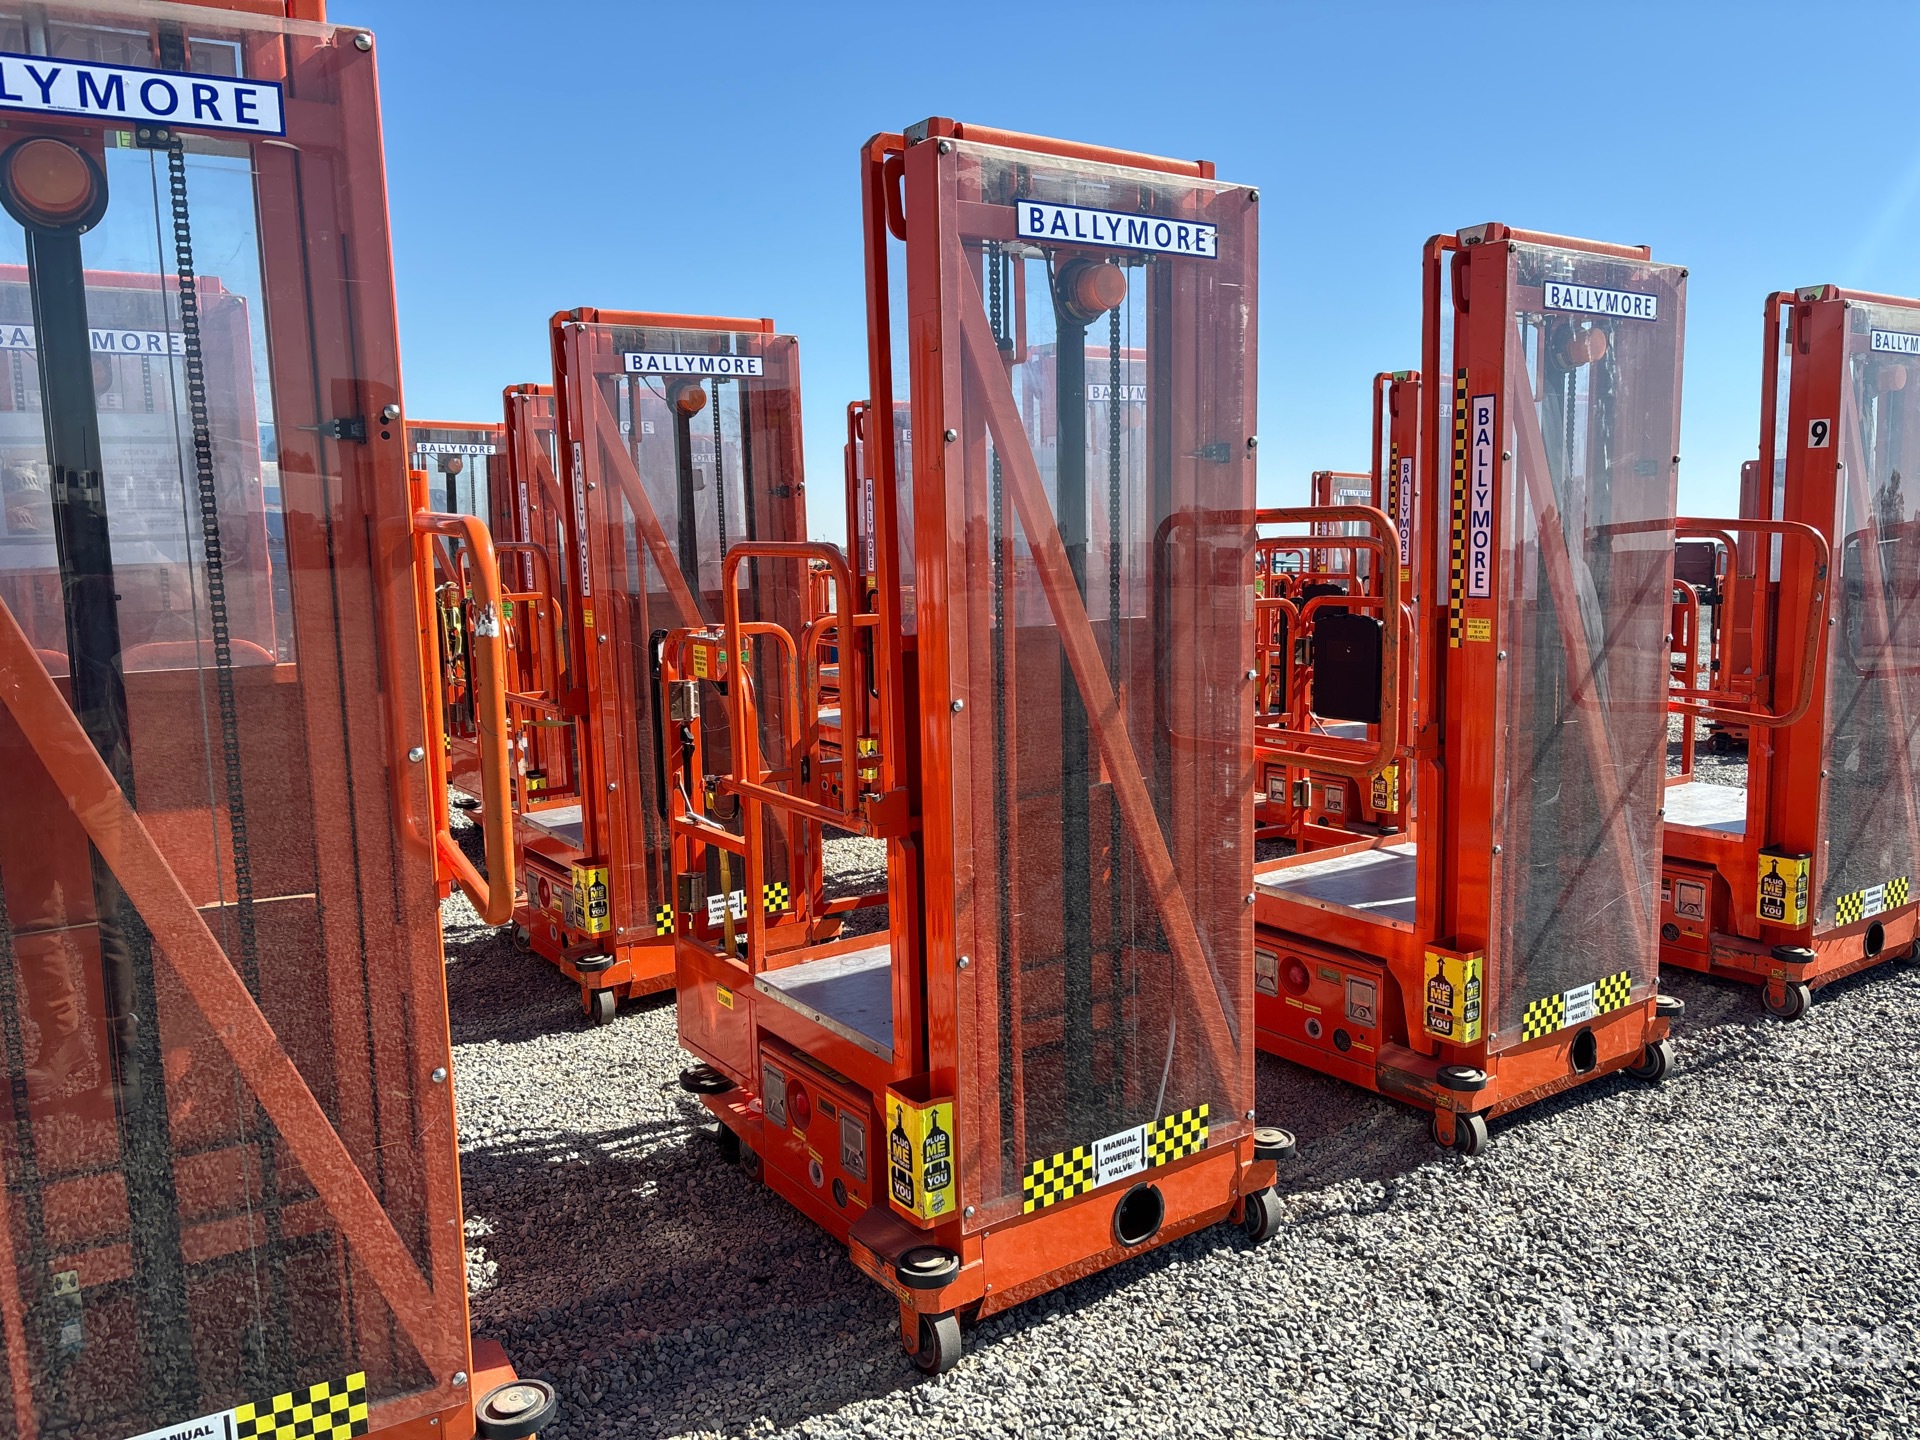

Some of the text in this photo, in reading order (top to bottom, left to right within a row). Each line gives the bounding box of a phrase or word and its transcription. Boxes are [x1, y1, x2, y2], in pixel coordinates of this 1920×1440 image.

[1029, 207, 1207, 252] BALLYMORE
[1551, 286, 1652, 317] BALLYMORE
[1875, 333, 1919, 352] BALLYM
[632, 355, 757, 374] BALLYMORE
[1810, 420, 1828, 447] 9
[421, 443, 492, 454] BALLYMORE
[1471, 406, 1490, 590] BALLYMORE
[574, 448, 589, 591] BALLYMORE
[1400, 463, 1411, 561] BALLYMORE
[866, 483, 875, 569] BALLYMORE
[521, 487, 533, 586] BALLYORE
[1374, 783, 1386, 791] ME
[1764, 877, 1783, 886] PLUG
[1764, 883, 1783, 894] ME
[590, 889, 604, 898] ME
[711, 895, 737, 905] MANAL
[591, 908, 606, 916] YOU
[1763, 906, 1782, 915] YOU
[1430, 980, 1451, 992] PLUG
[1466, 986, 1479, 997] ME
[1430, 987, 1450, 1003] ME
[1430, 1017, 1450, 1030] YOU
[892, 1132, 910, 1150] PLUG
[925, 1133, 946, 1147] PLUG
[1102, 1134, 1137, 1152] MANUAL
[892, 1141, 910, 1165] ME
[926, 1140, 946, 1158] ME
[931, 1152, 946, 1161] TODAY
[1099, 1146, 1141, 1167] LOWERING
[1107, 1161, 1134, 1177] VALVE
[927, 1172, 948, 1187] YOU
[894, 1181, 912, 1201] YOU
